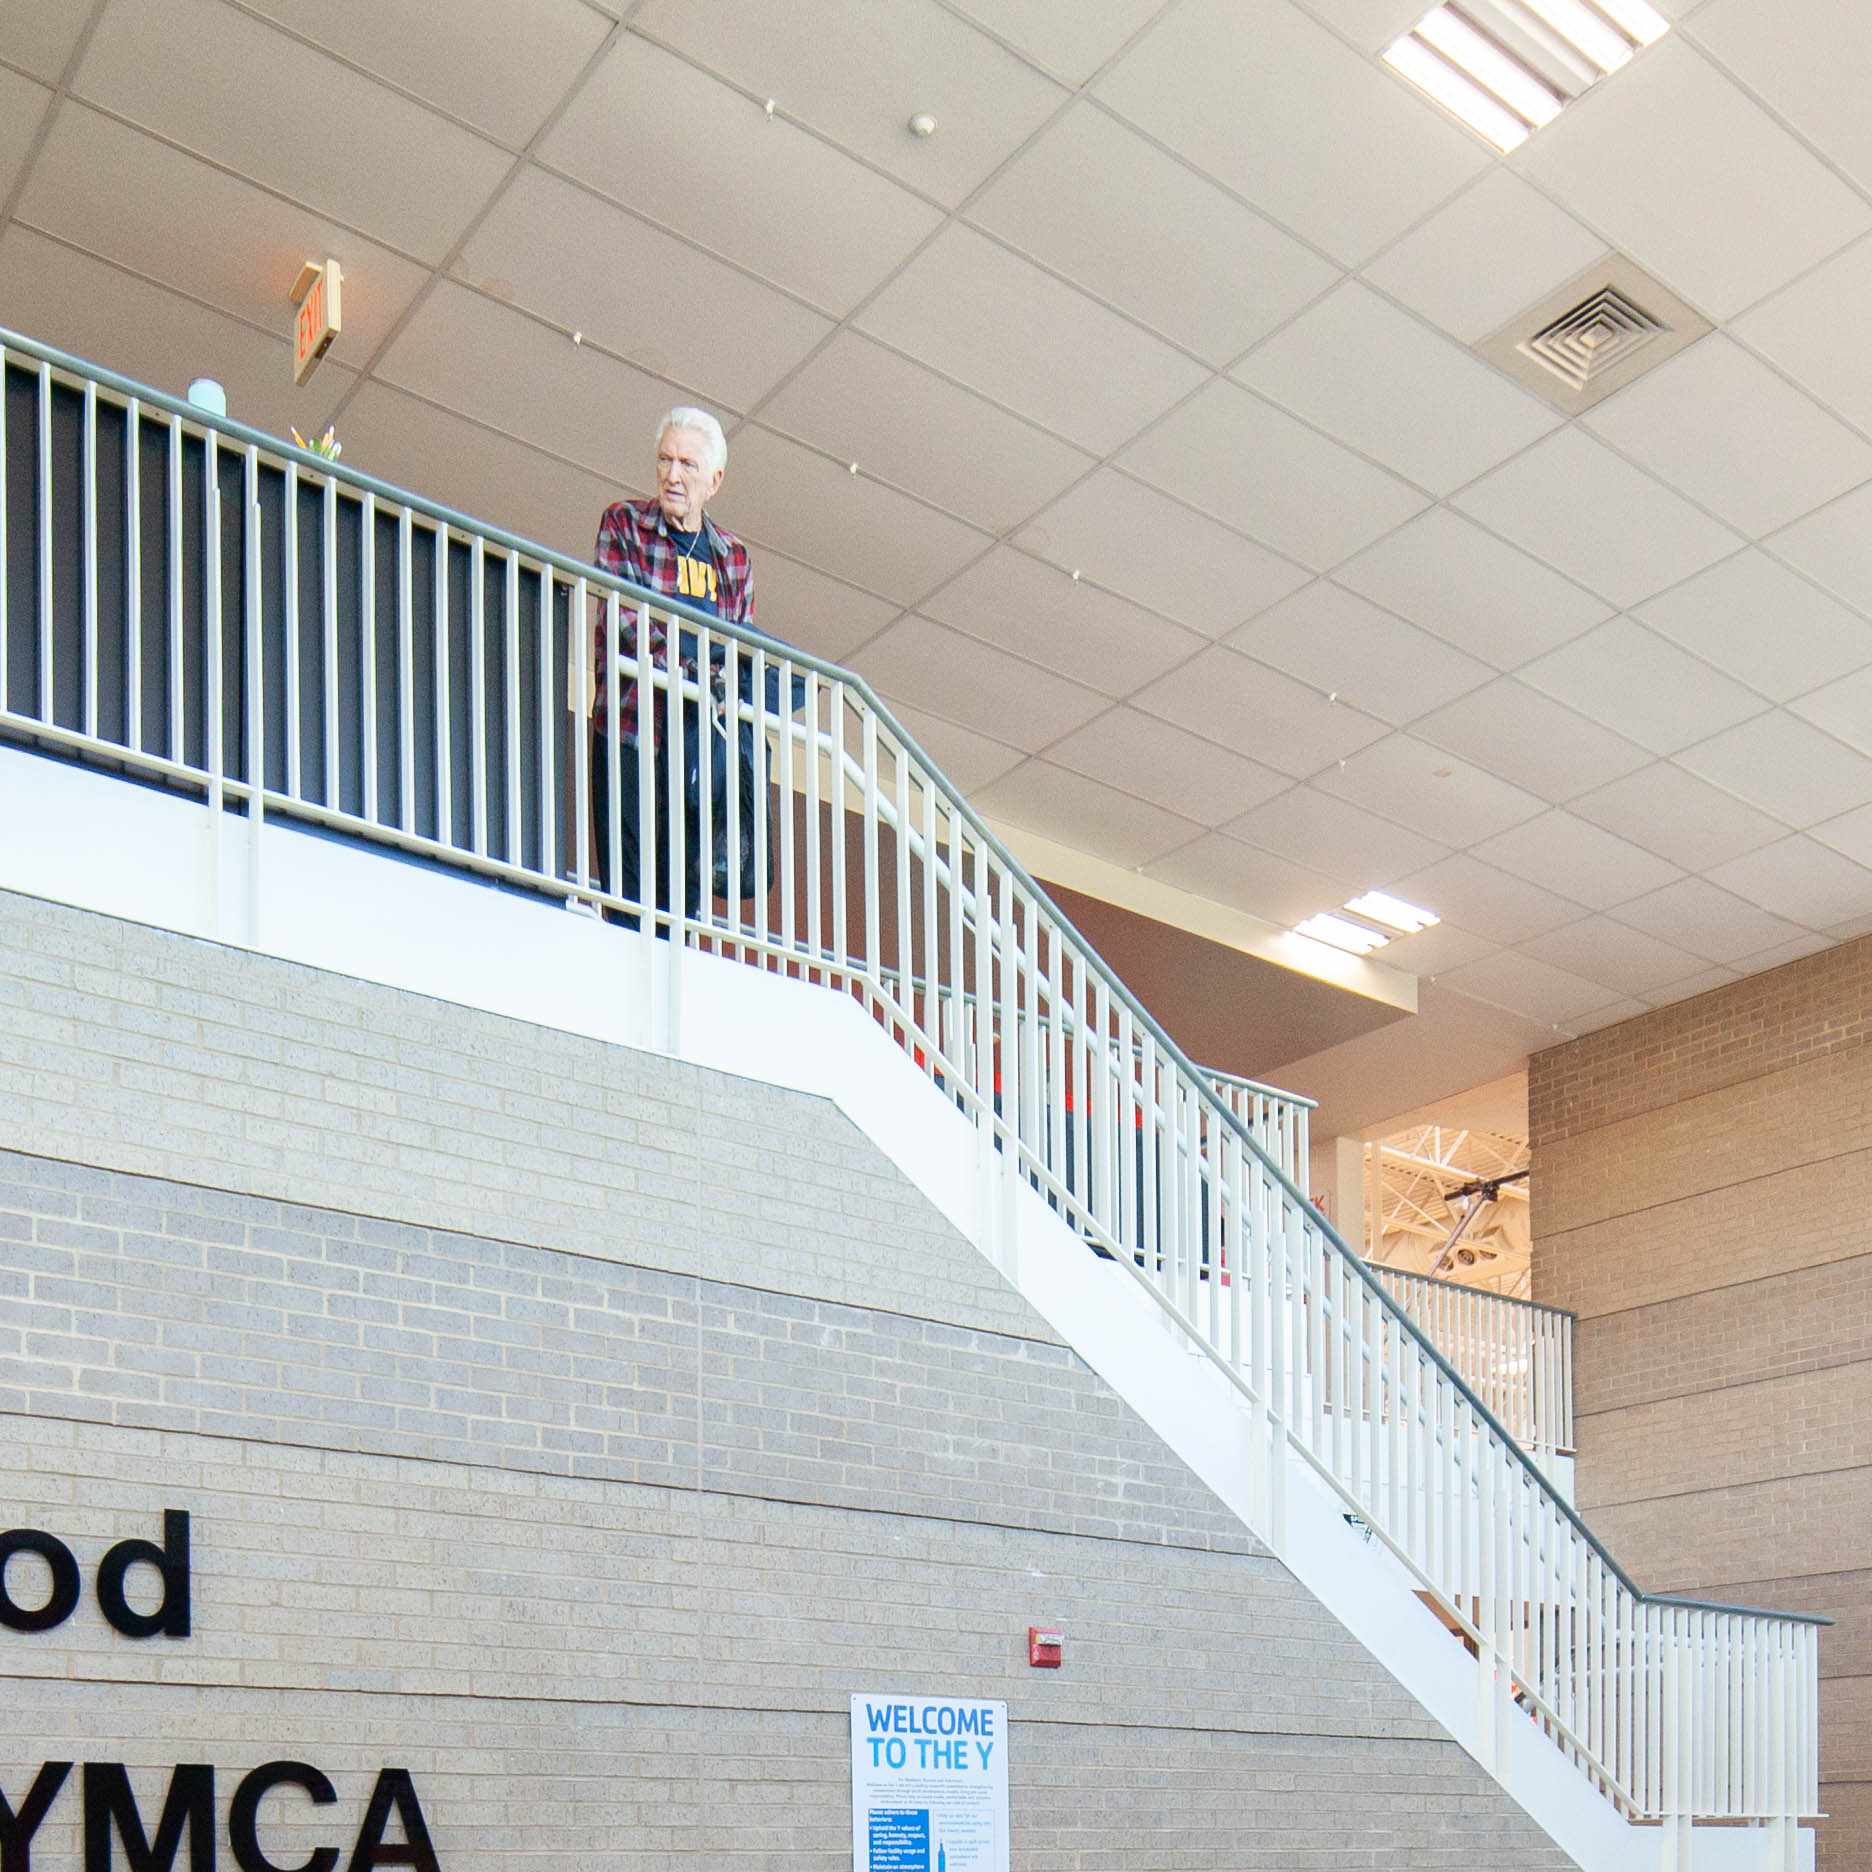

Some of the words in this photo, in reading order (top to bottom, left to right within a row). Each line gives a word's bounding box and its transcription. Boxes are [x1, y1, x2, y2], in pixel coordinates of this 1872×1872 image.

[299, 280, 323, 360] EXIT
[865, 1703, 995, 1737] WELCOME
[866, 1736, 906, 1769] TO
[914, 1739, 969, 1770] THE
[975, 1741, 994, 1771] Y
